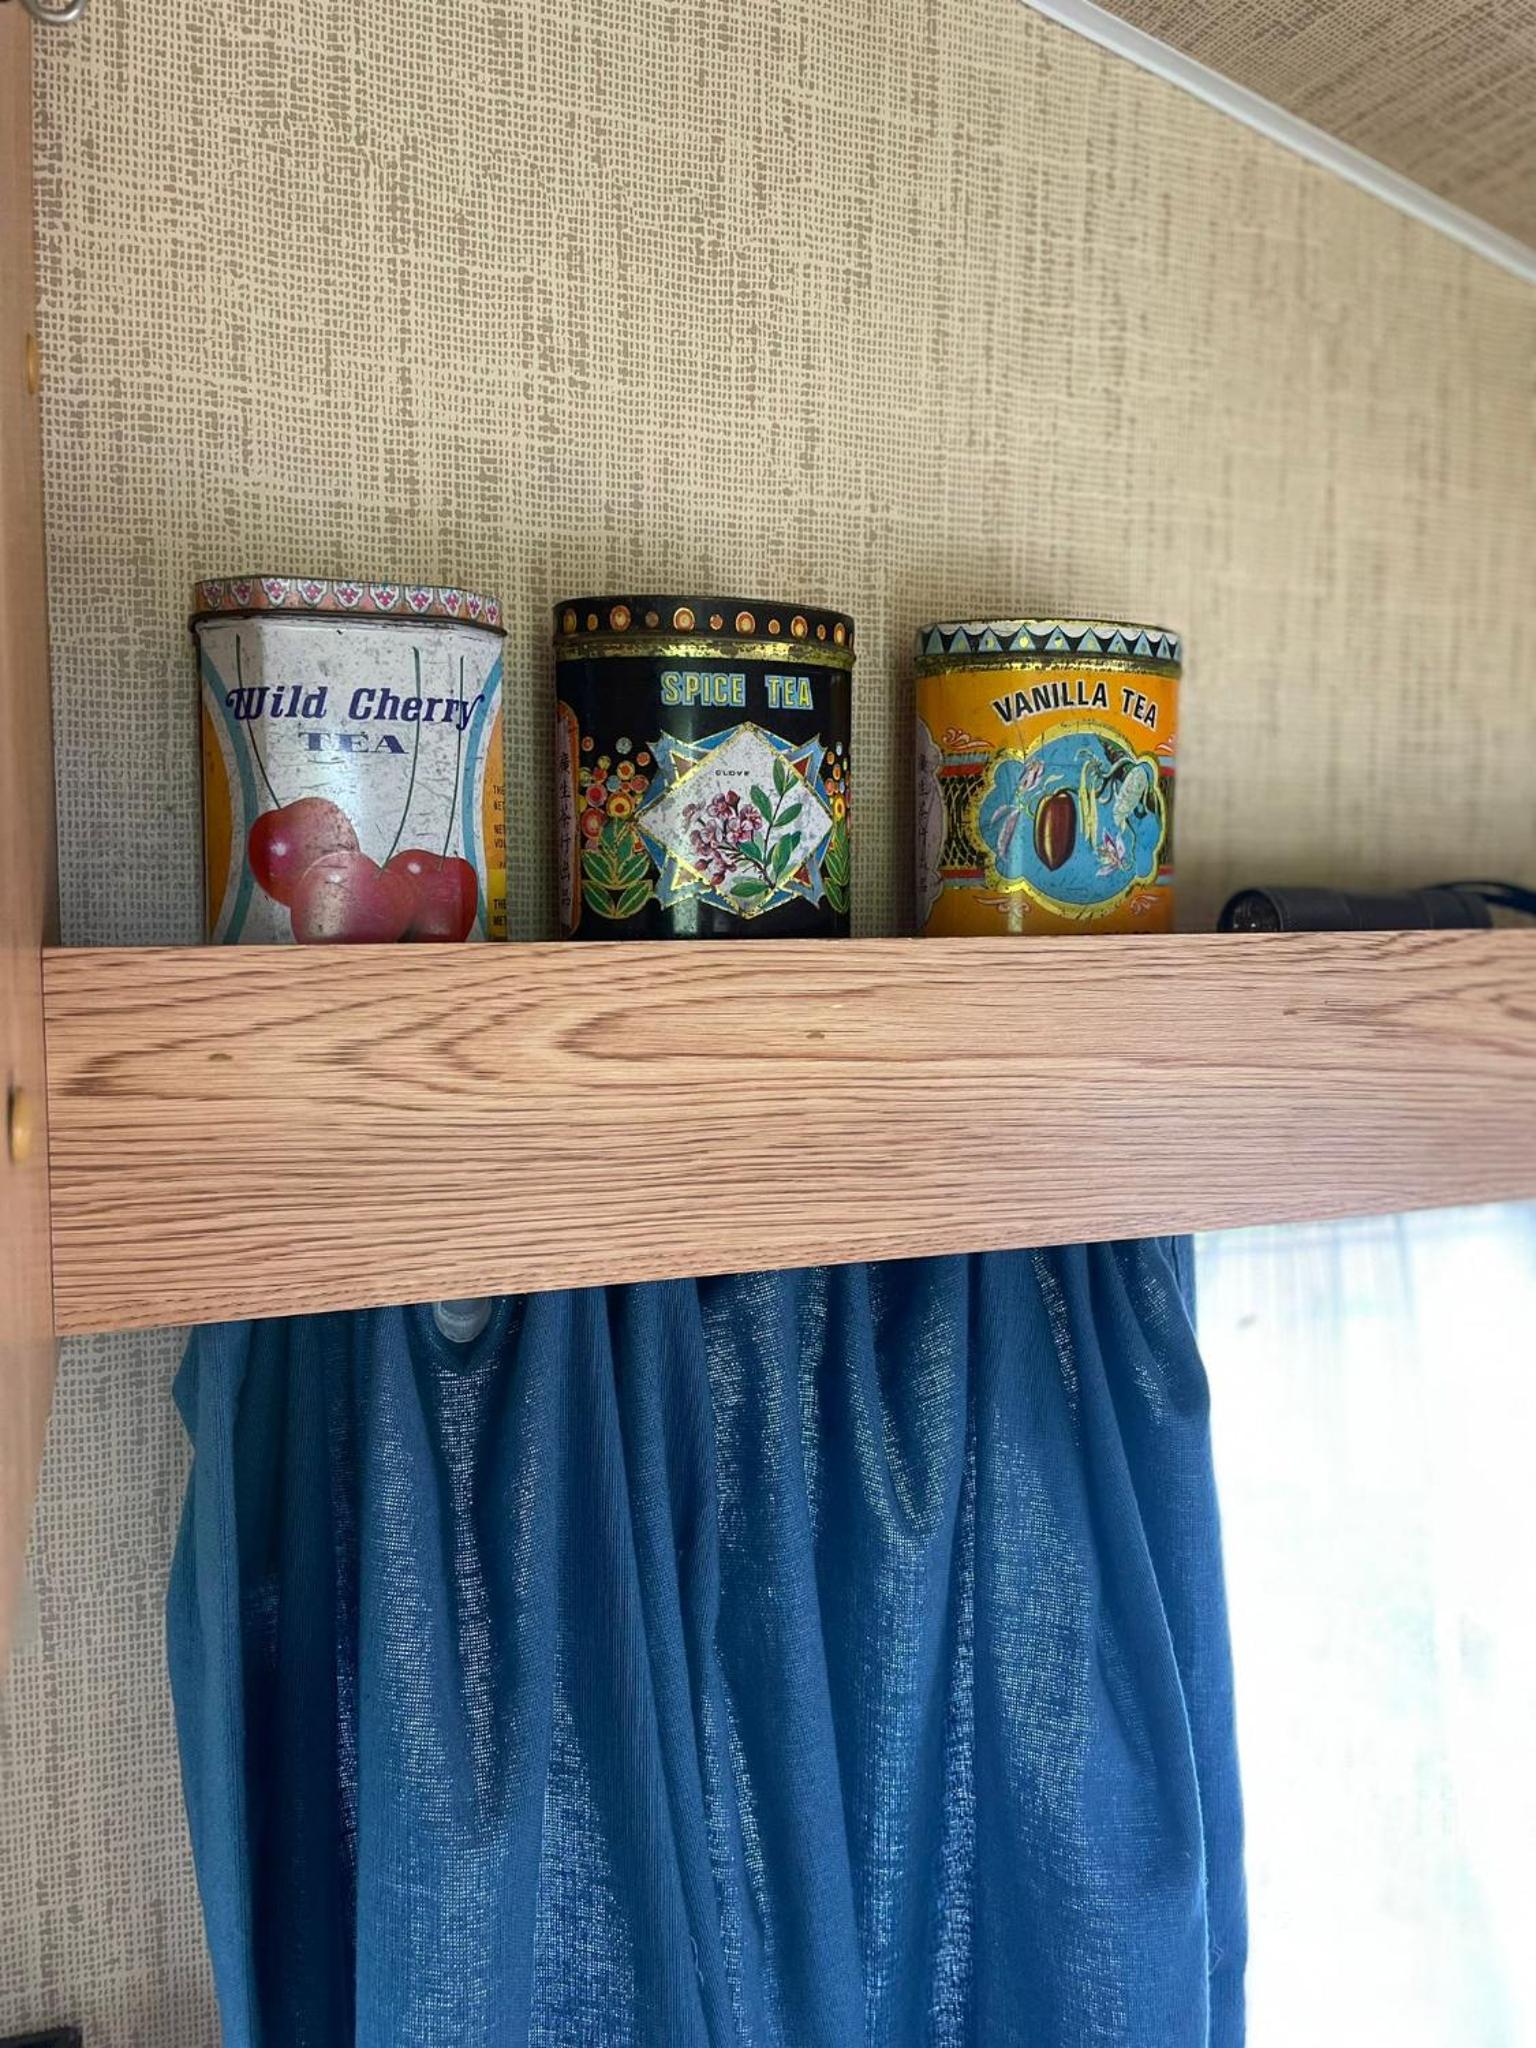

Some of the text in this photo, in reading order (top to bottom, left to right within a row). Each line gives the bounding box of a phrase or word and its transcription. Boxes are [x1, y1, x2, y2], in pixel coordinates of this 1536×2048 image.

[225, 685, 486, 731] Wild Cherry
[661, 671, 814, 710] SPICE TEA
[992, 680, 1158, 731] VANILLA TEA
[298, 731, 410, 755] TEA
[715, 769, 751, 777] CLOVE
